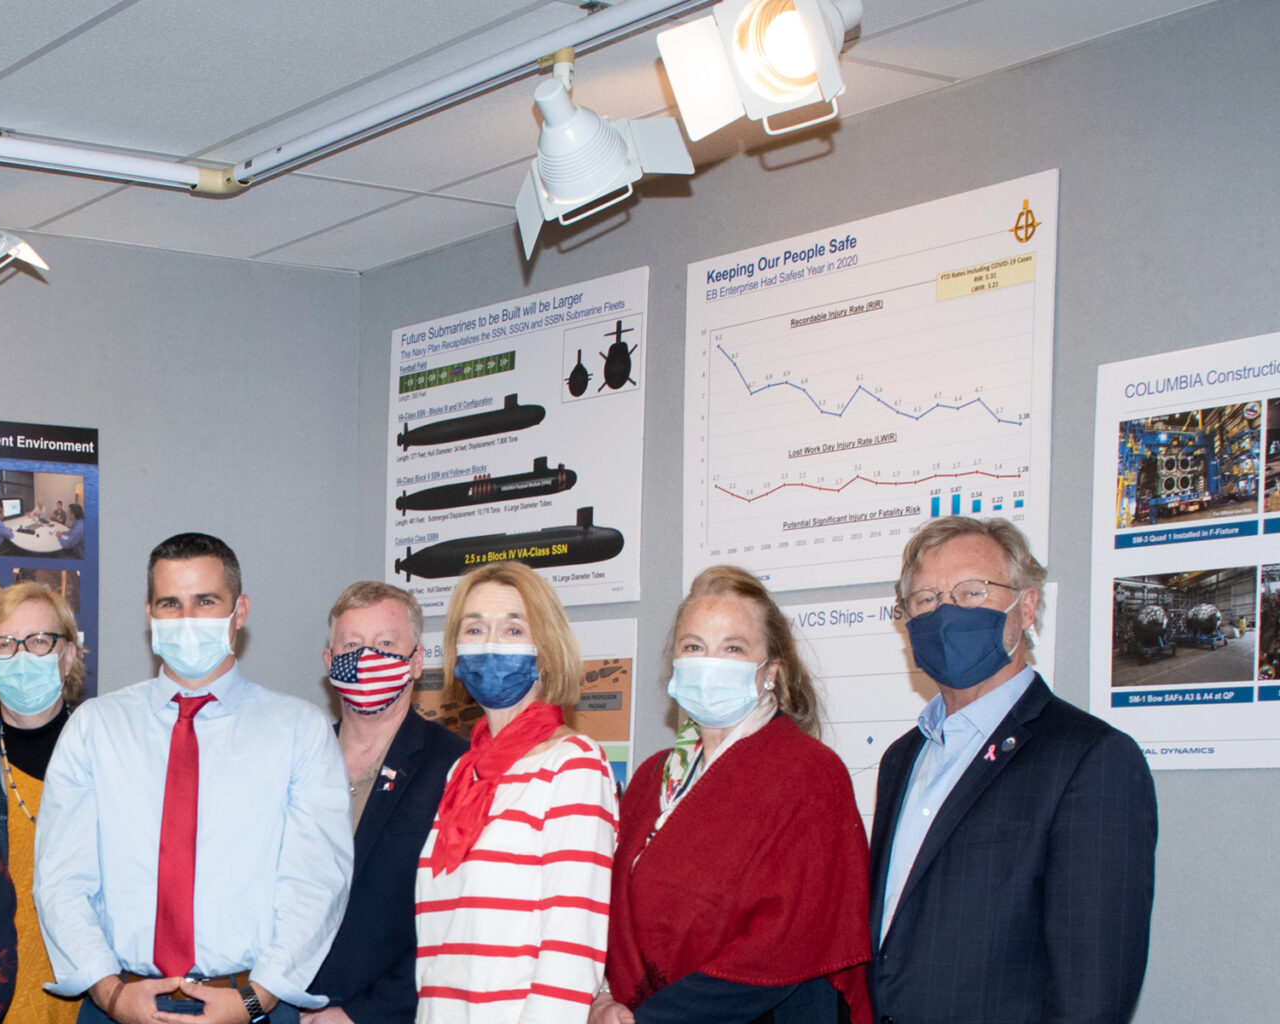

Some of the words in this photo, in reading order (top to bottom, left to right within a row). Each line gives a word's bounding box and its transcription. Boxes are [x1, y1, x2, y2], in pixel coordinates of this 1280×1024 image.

[706, 262, 754, 284] Keeping
[758, 256, 781, 271] Our
[783, 243, 825, 265] People
[829, 234, 857, 254] Safe
[991, 258, 1016, 270] COVID-19
[1017, 255, 1032, 264] Cases
[706, 289, 718, 301] EB
[720, 280, 759, 297] Enterprise
[761, 274, 777, 288] Had
[779, 268, 805, 284] Safest
[807, 264, 826, 276] Year
[827, 260, 834, 271] in
[837, 254, 858, 270] 2020
[401, 330, 426, 346] Future
[428, 319, 476, 340] Submarines
[478, 316, 486, 328] to
[489, 313, 499, 325] be
[501, 306, 521, 322] Built
[523, 302, 536, 316] will
[539, 301, 550, 313] be
[553, 293, 583, 309] Larger
[790, 312, 827, 327] Recordable
[829, 308, 847, 319] Injury
[849, 304, 864, 314] Rate
[866, 299, 883, 311] (RIR)
[401, 350, 411, 359] The
[413, 347, 426, 357] Navy
[428, 343, 440, 352] Plan
[481, 332, 490, 341] the
[510, 322, 529, 335] SSGN
[531, 319, 543, 329] and
[545, 314, 564, 326] SSBN
[566, 305, 602, 321] Submarine
[604, 300, 625, 312] Fleets
[1125, 372, 1204, 399] COLUMBIA
[17, 435, 95, 453] Environment
[788, 448, 802, 457] Lost
[804, 446, 820, 454] Work
[822, 443, 835, 452] Day
[837, 440, 856, 450] Injury
[857, 437, 872, 446] Rate
[874, 433, 897, 444] (LWIR)
[783, 519, 810, 531] Potential
[812, 514, 847, 526] Significant
[849, 512, 867, 522] Injury
[869, 511, 876, 519] or
[878, 507, 904, 518] Fatality
[905, 505, 920, 514] Risk
[1132, 536, 1148, 544] SM-3
[1149, 534, 1167, 542] Quad
[1173, 531, 1200, 540] Installed
[1209, 527, 1239, 536] F-Fixture
[465, 553, 475, 564] 2.5
[482, 554, 486, 562] a
[488, 550, 507, 562] Block
[509, 549, 516, 559] IV
[518, 546, 550, 558] VA-Class
[552, 544, 568, 555] SSN
[799, 610, 825, 627] VCS
[830, 609, 864, 627] Ships
[1129, 695, 1145, 703] SM-1
[1147, 694, 1162, 702] Bow
[1164, 693, 1183, 702] SAFs
[1184, 693, 1194, 701] A3
[1203, 692, 1213, 700] A4
[1161, 747, 1215, 755] DYNAMICS
